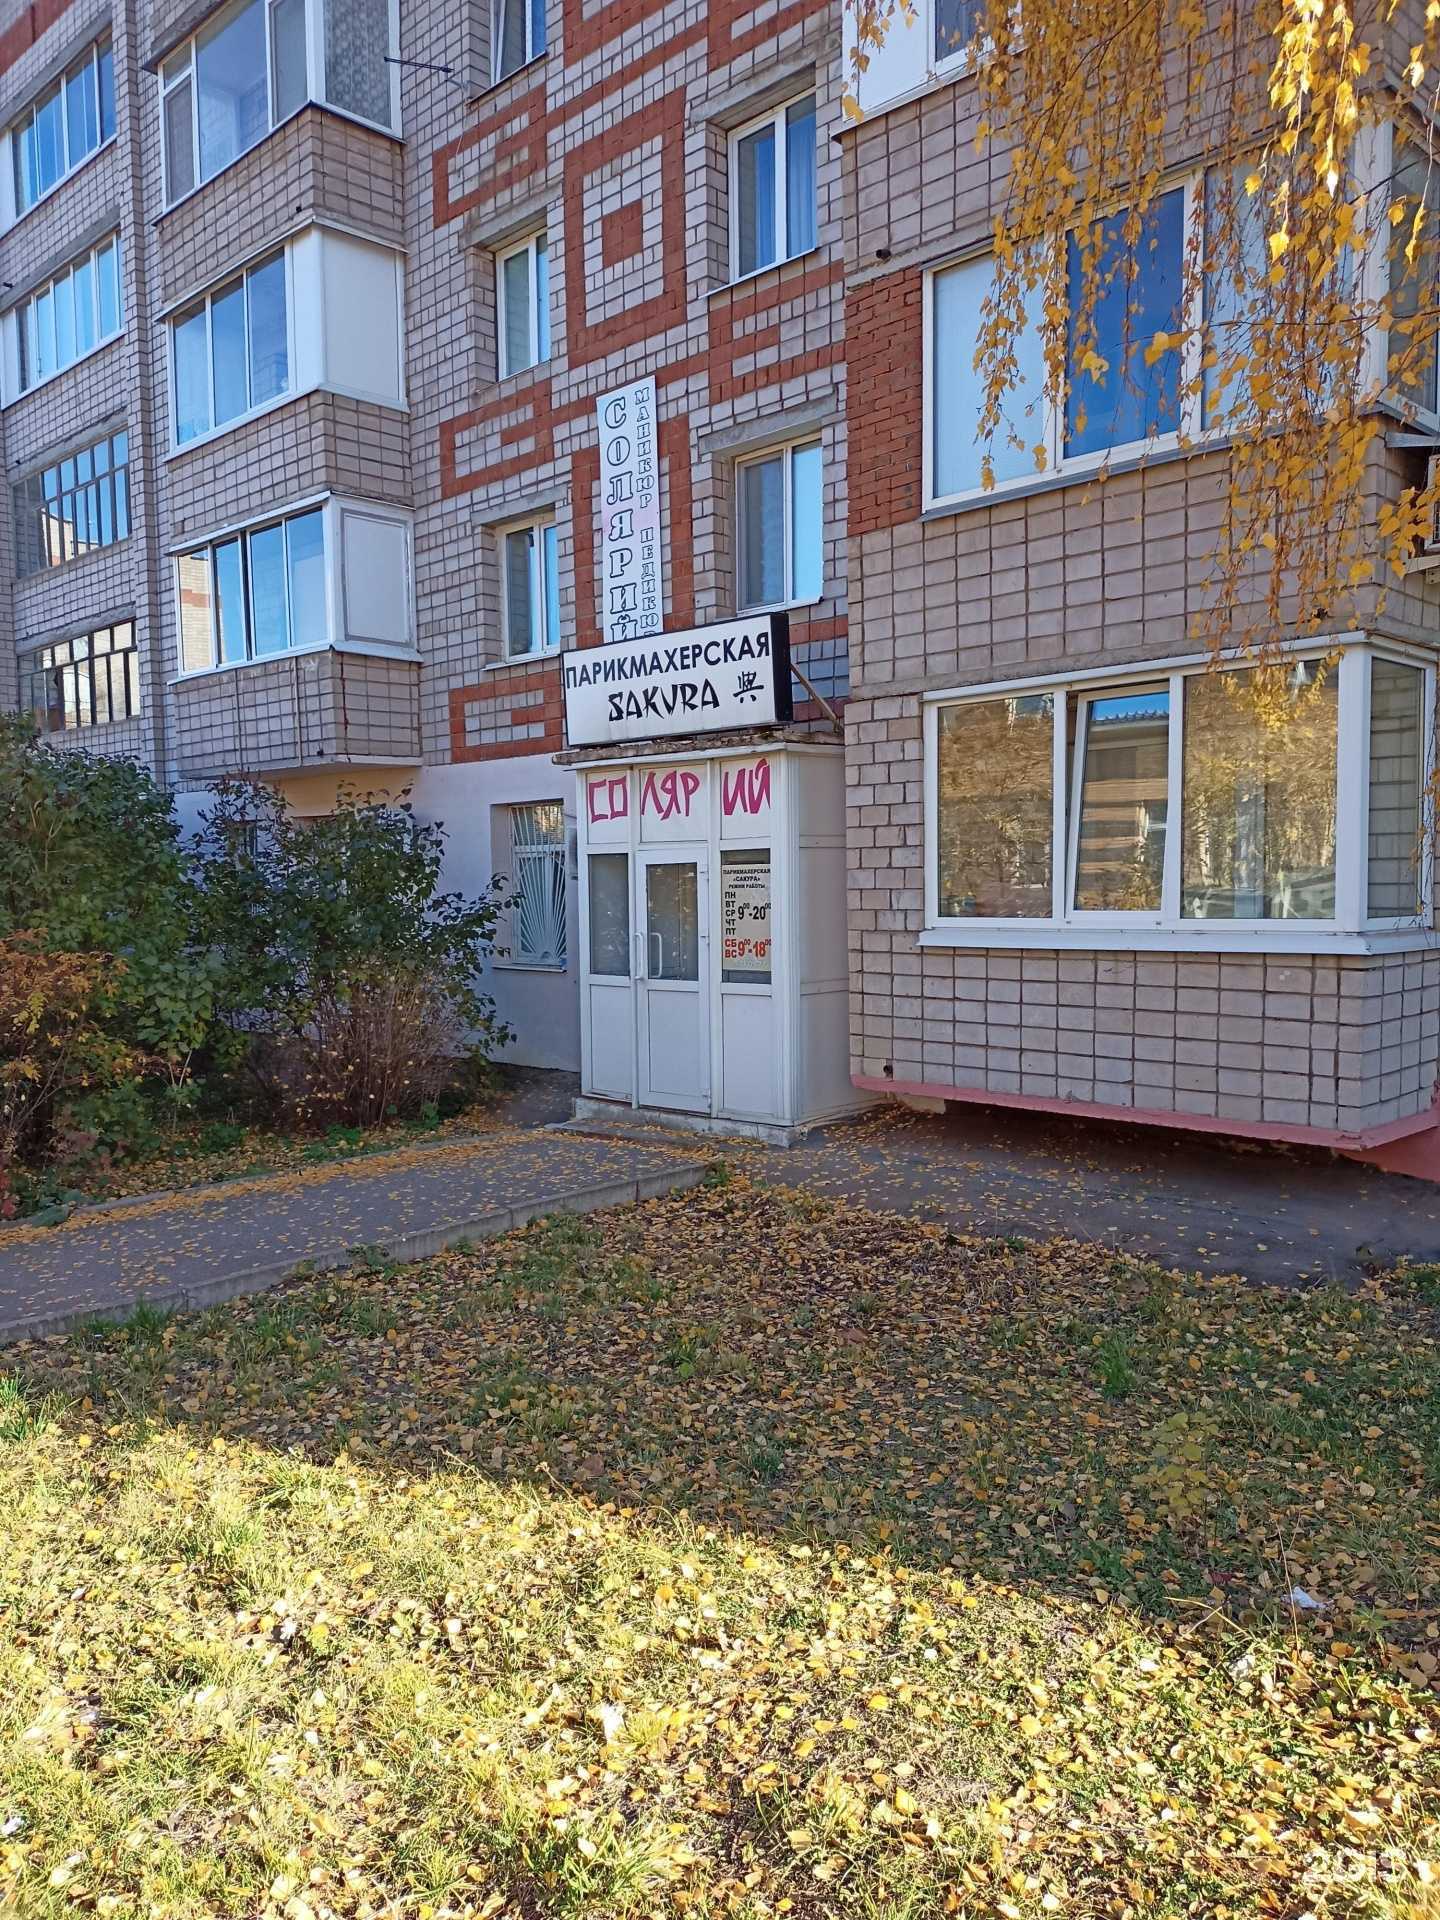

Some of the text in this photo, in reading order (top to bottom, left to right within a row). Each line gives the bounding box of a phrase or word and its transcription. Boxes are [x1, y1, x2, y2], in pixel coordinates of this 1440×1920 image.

[635, 387, 655, 509] МАНИКЮР
[605, 396, 638, 642] СОЛЯРИЙ
[566, 631, 770, 689] ПАРИКМАХЕРСКАЯ
[725, 939, 737, 947] СБ
[725, 949, 737, 958] ВС
